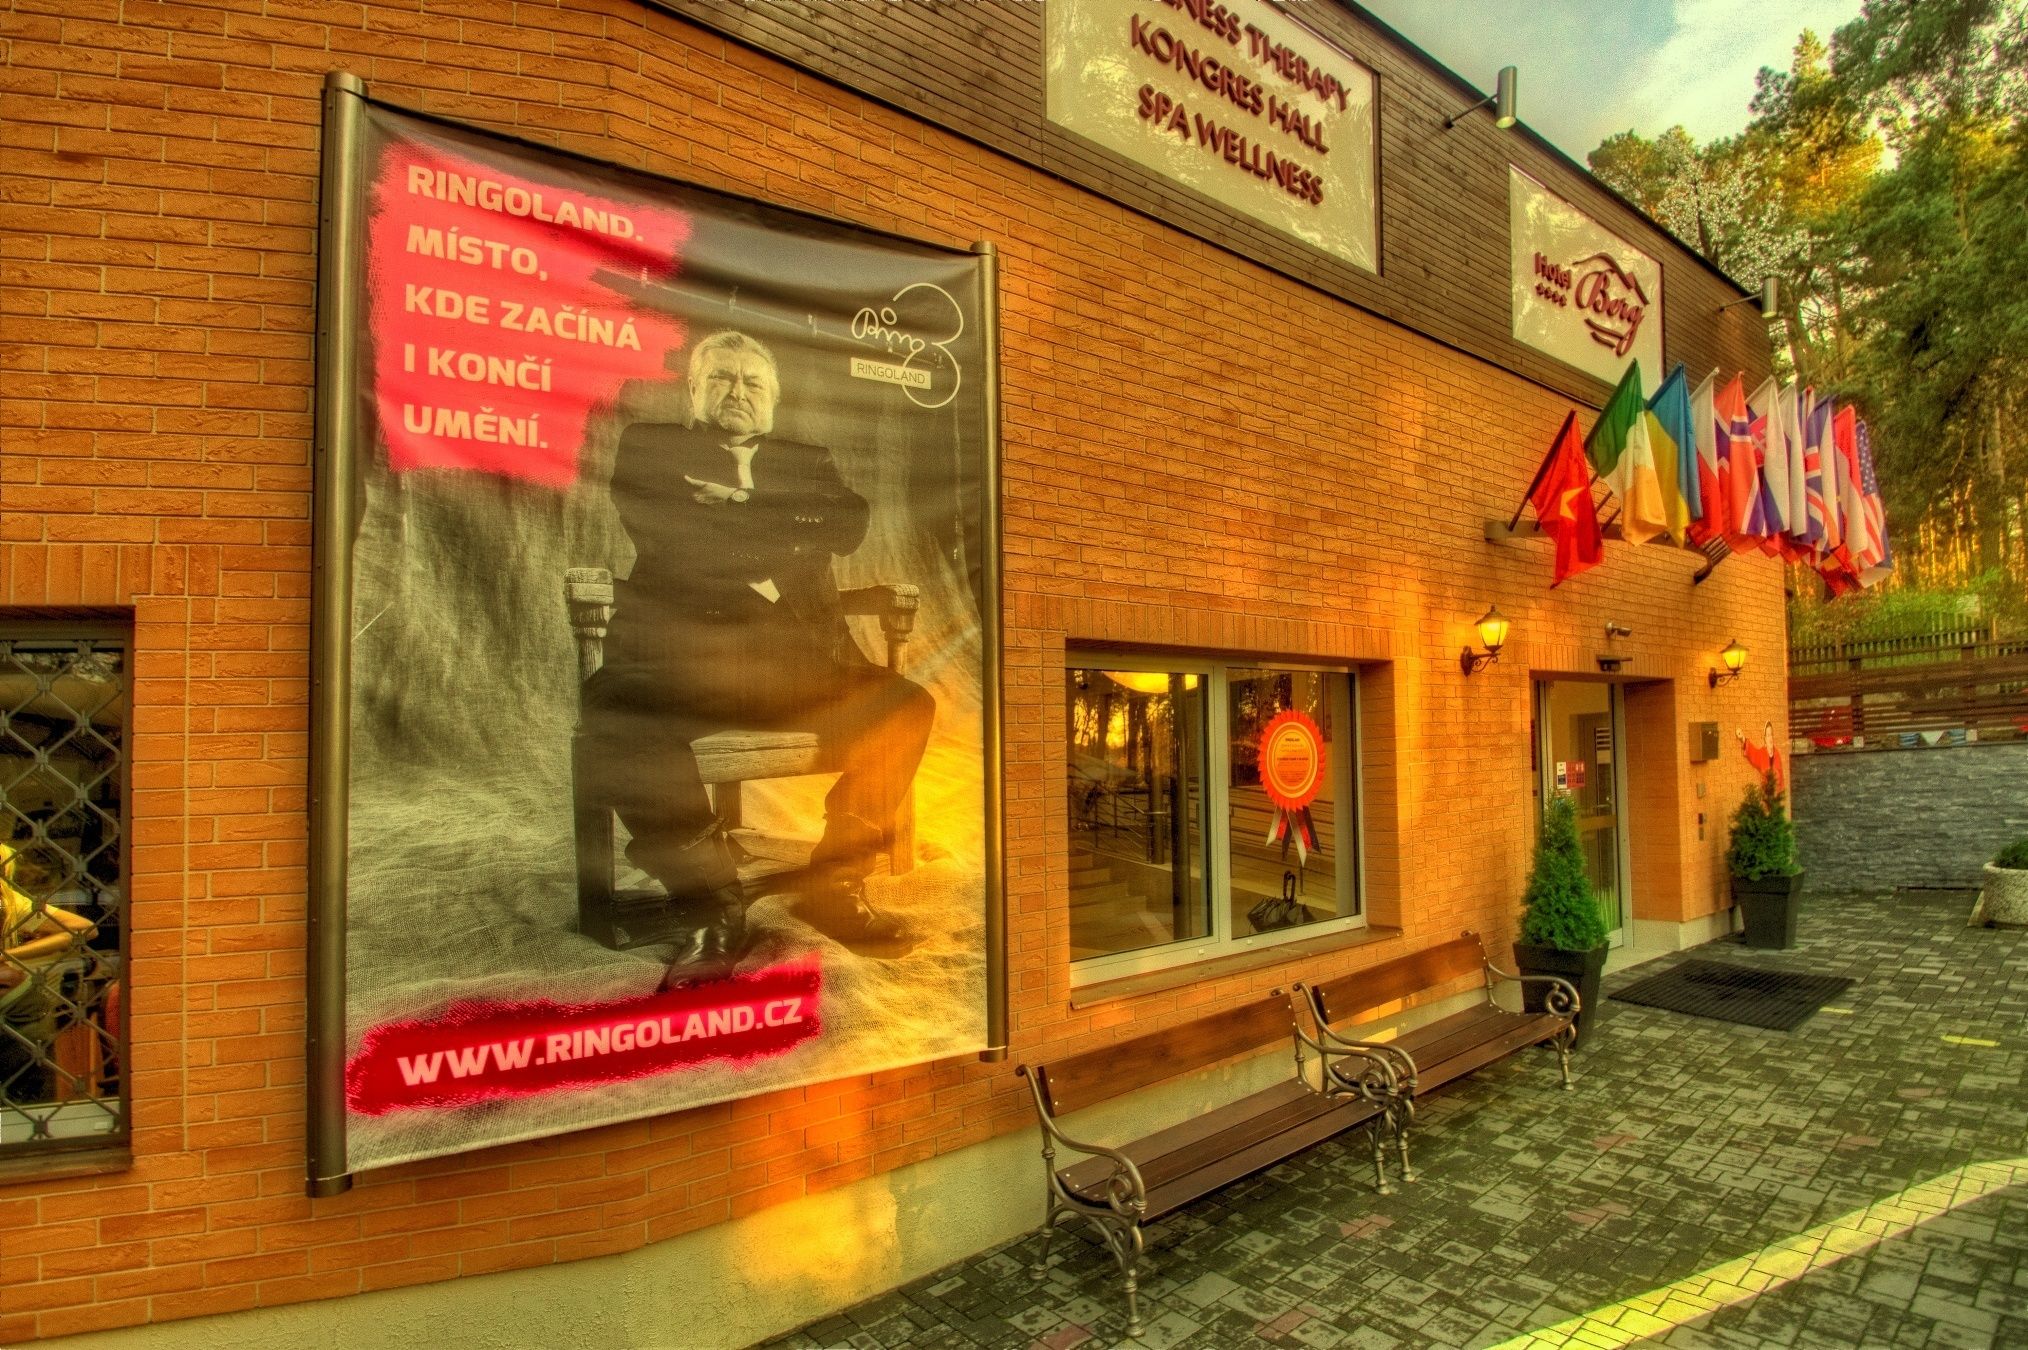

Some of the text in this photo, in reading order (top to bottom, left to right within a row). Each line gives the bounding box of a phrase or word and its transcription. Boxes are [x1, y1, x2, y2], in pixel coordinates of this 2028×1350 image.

[1131, 13, 1330, 154] KONGRES HALL
[1245, 22, 1351, 112] THERAPY
[1138, 83, 1324, 206] SPA WELLNESS
[407, 164, 644, 242] RINGOLAND.
[405, 225, 548, 282] MÍSTO,
[1534, 251, 1572, 291] Hotel
[405, 283, 642, 351] KDE ZAČÍNÁ
[404, 343, 553, 393] I KONČÍ
[857, 362, 926, 385] RINGOLAND
[404, 403, 548, 449] UMĚNÍ.
[397, 997, 803, 1087] WWW.RINGOLAND.CZ
